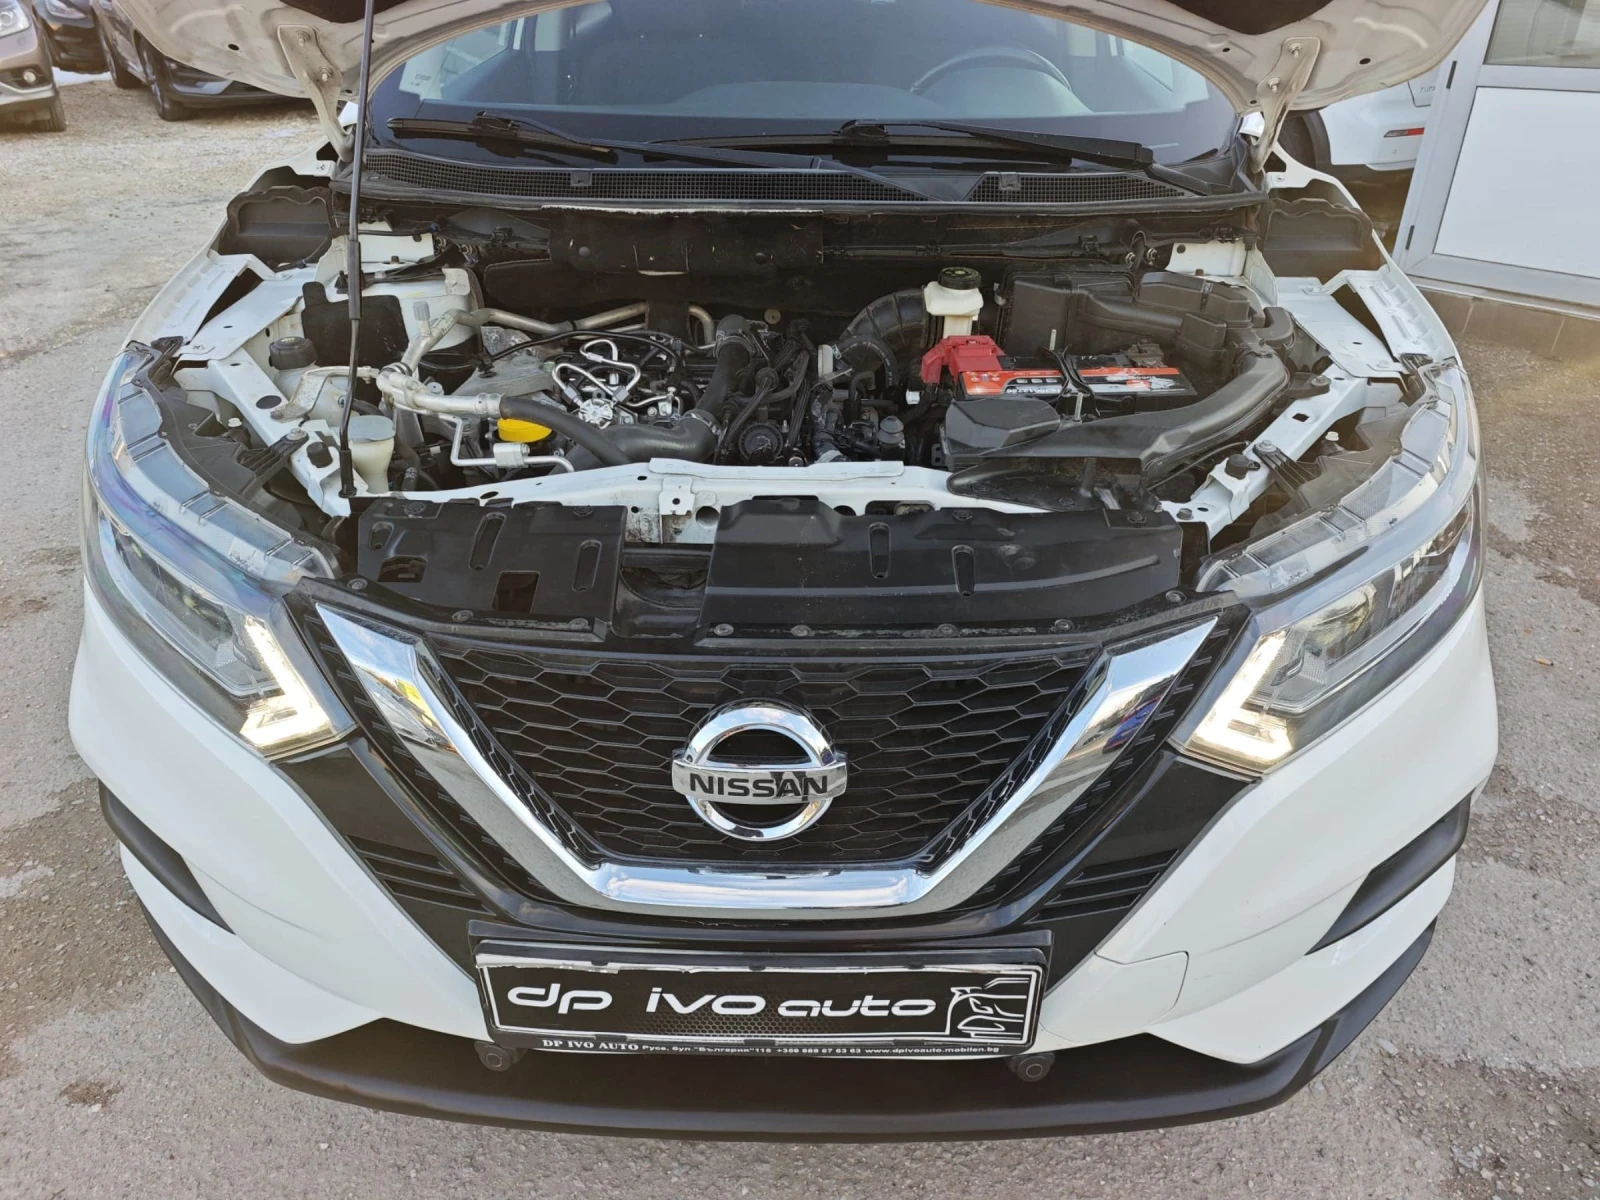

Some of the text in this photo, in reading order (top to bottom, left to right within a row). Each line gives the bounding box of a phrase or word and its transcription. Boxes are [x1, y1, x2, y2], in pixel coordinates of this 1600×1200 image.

[690, 773, 828, 798] NISSAN
[507, 983, 936, 1017] dp ivo auto
[542, 1039, 563, 1047] DP
[567, 1040, 595, 1049] IVO
[599, 1042, 639, 1051] AUTO
